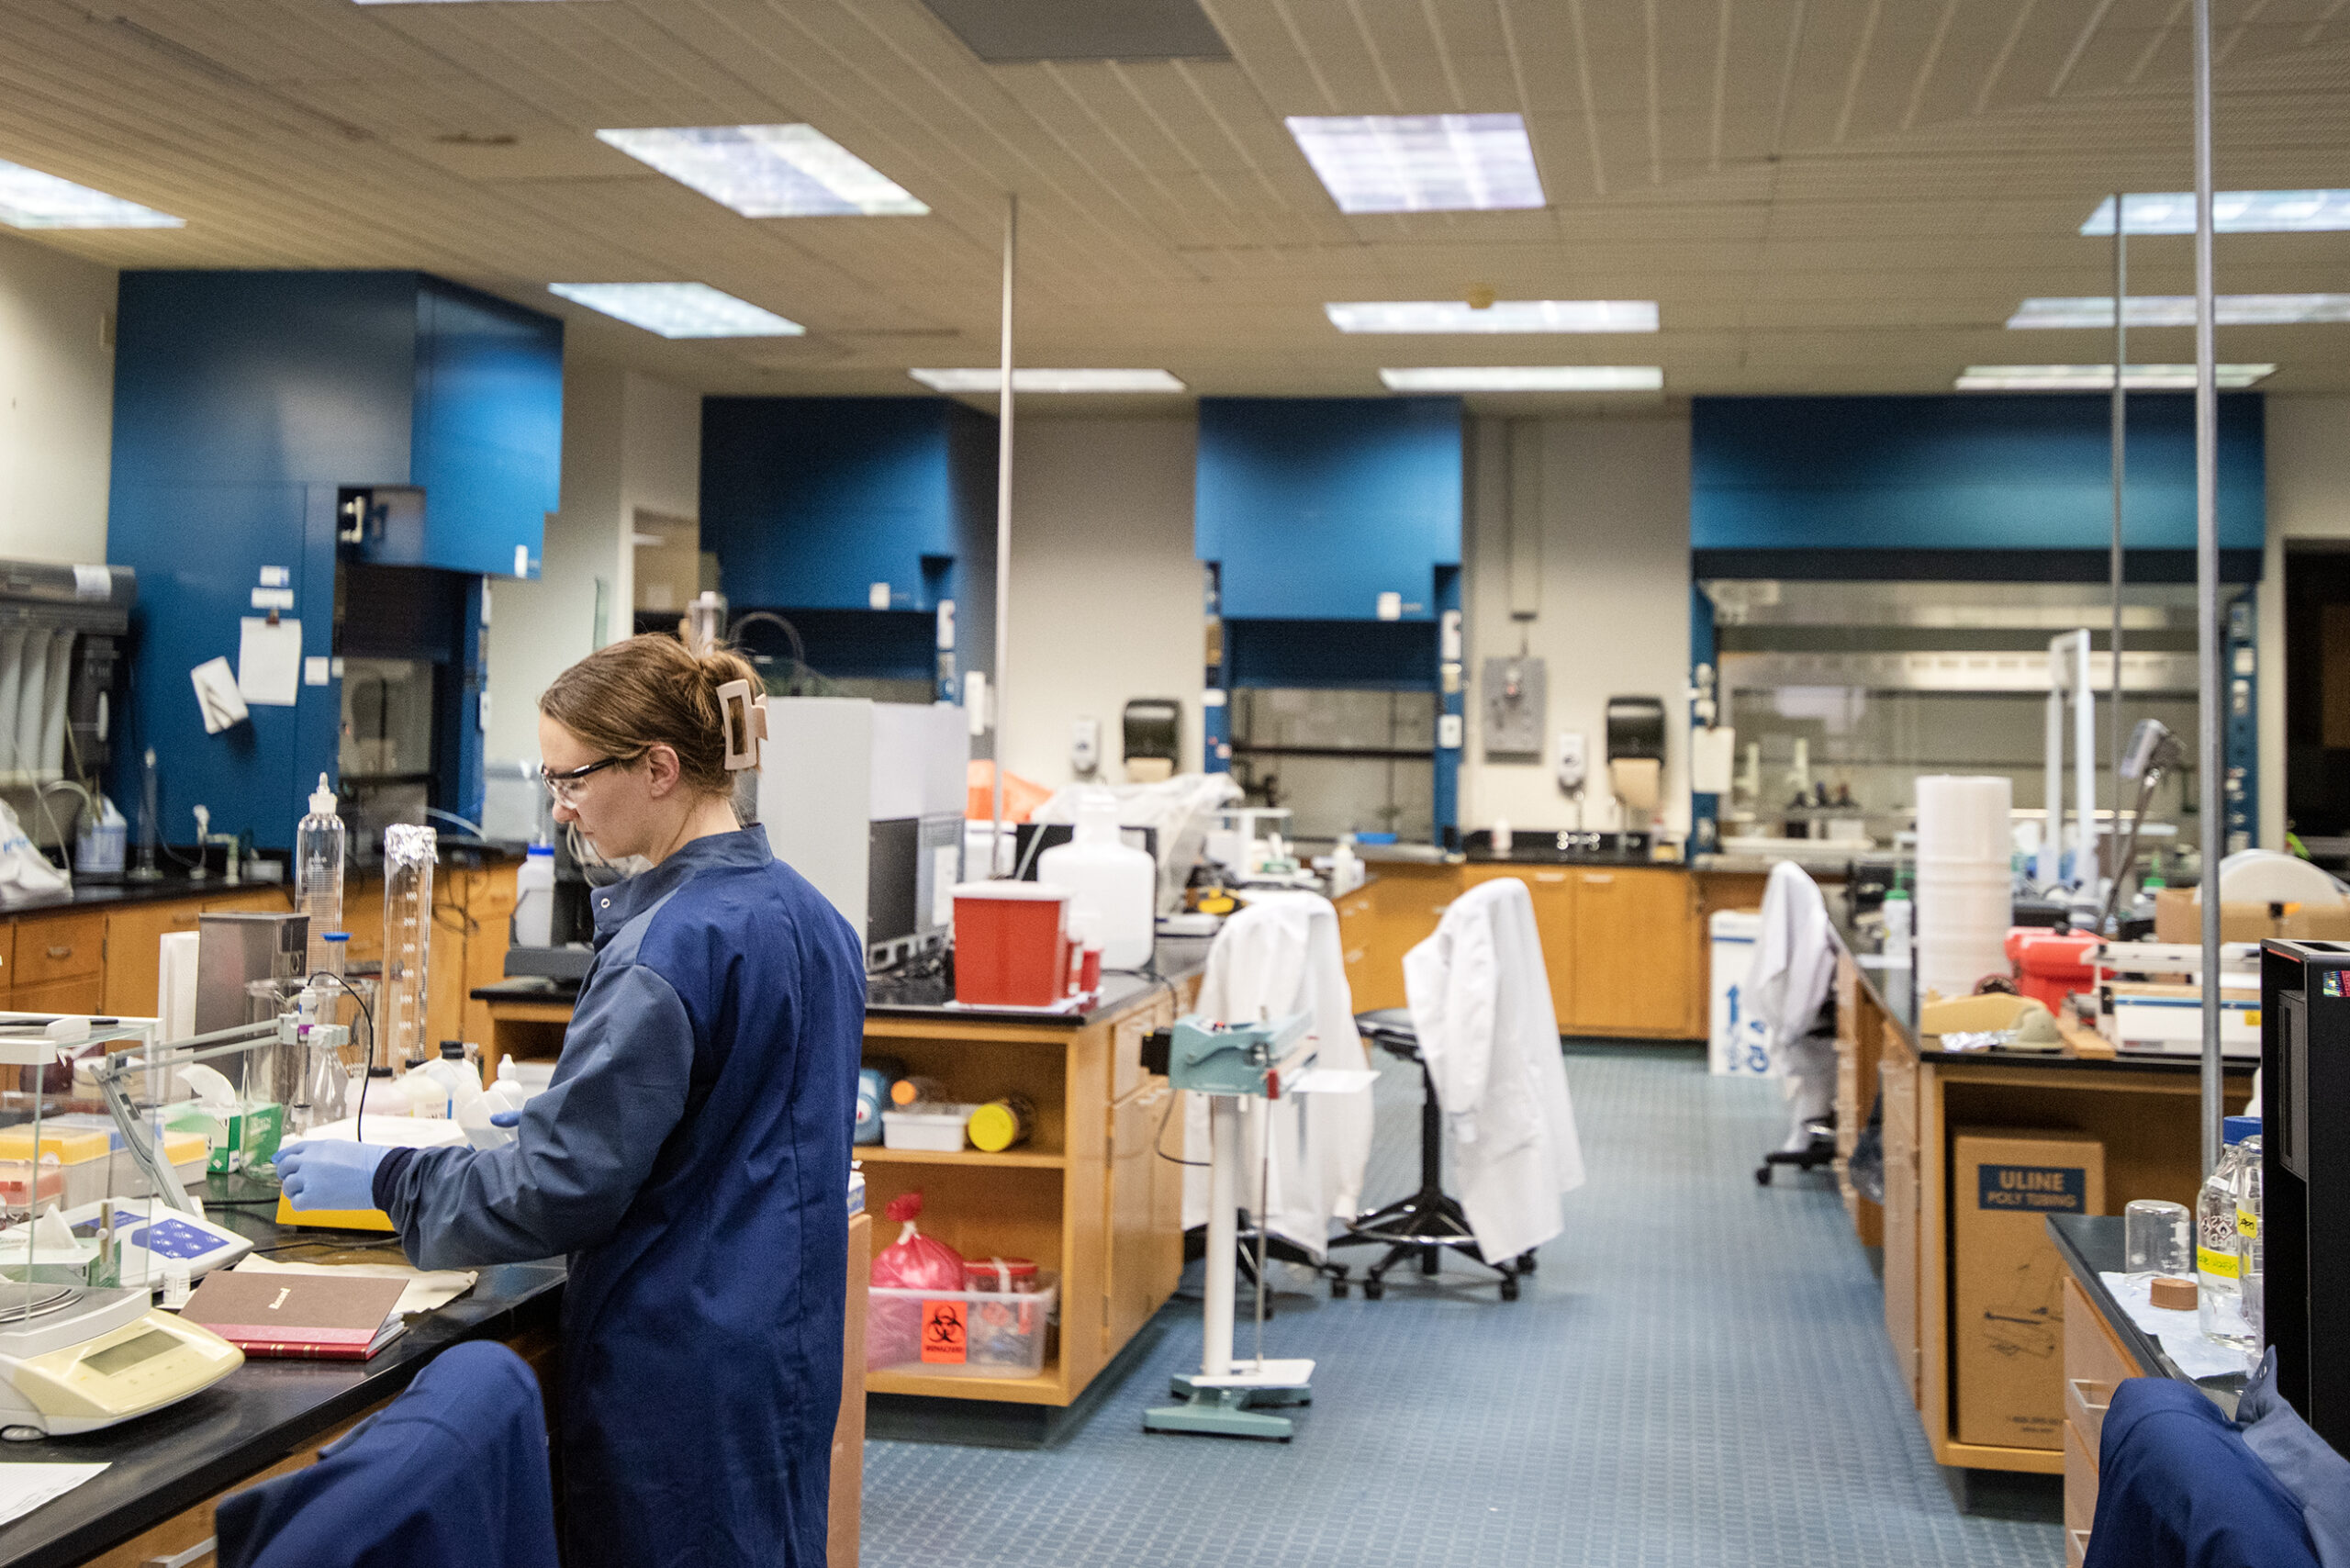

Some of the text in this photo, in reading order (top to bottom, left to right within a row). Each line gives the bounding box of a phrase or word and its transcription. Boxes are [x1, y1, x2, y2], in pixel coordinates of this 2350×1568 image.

[1999, 1170, 2065, 1192] ULINE
[1986, 1191, 2077, 1208] POLY TUBING
